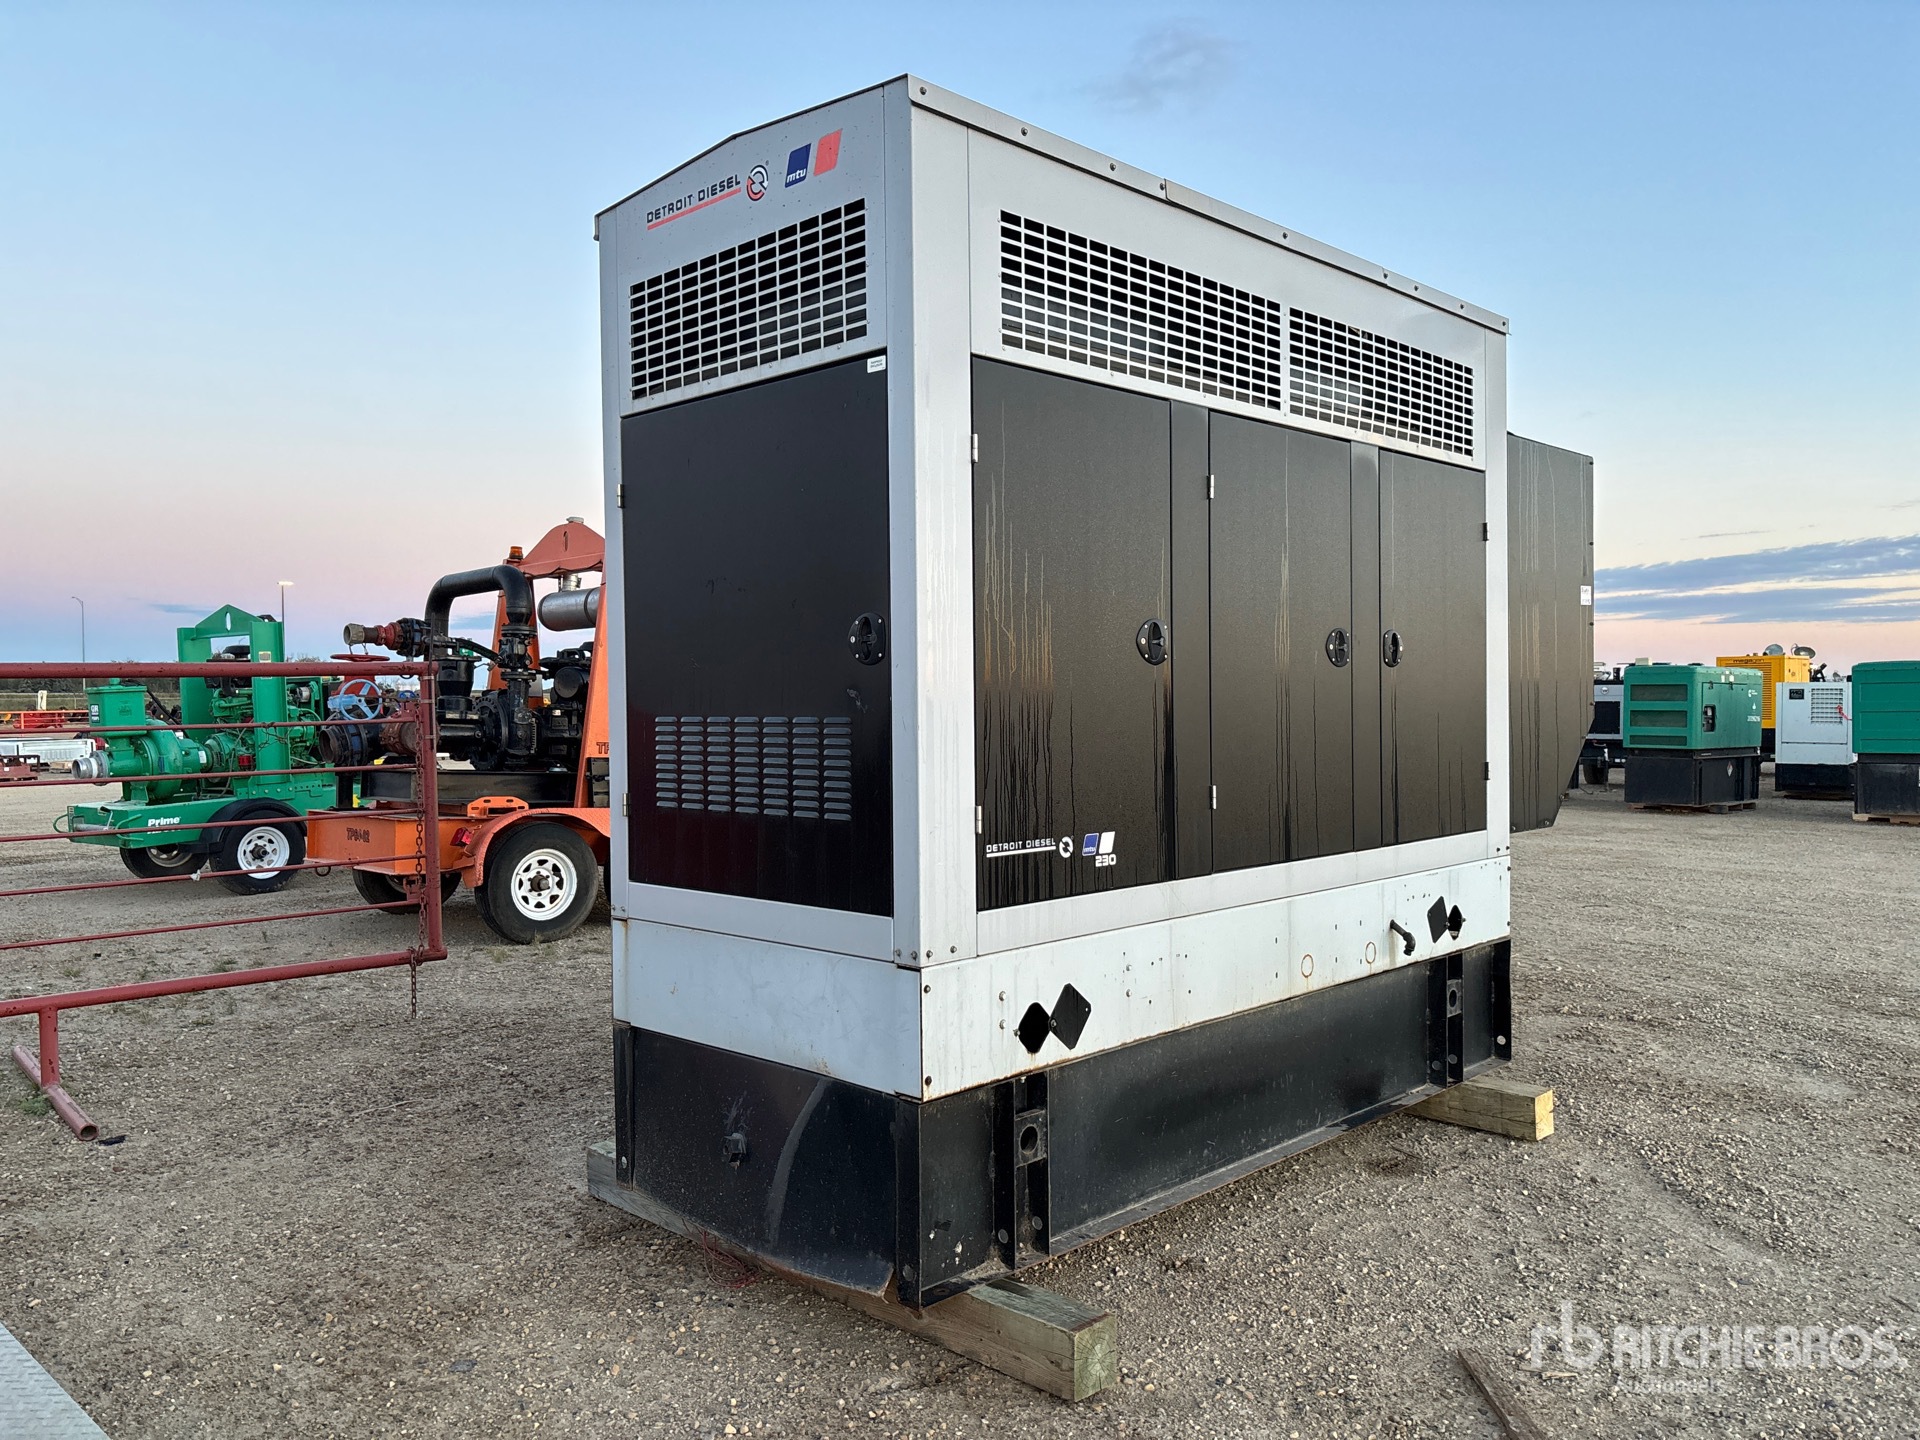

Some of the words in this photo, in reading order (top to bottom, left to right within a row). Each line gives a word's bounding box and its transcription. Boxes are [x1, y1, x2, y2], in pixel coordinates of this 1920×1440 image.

[786, 168, 806, 184] mtu
[646, 194, 693, 223] DETROIT
[697, 174, 741, 202] DIESEL
[147, 816, 180, 828] Prime
[986, 841, 1022, 853] DETROIT
[1025, 837, 1056, 848] DIESEL
[1095, 853, 1117, 867] 230
